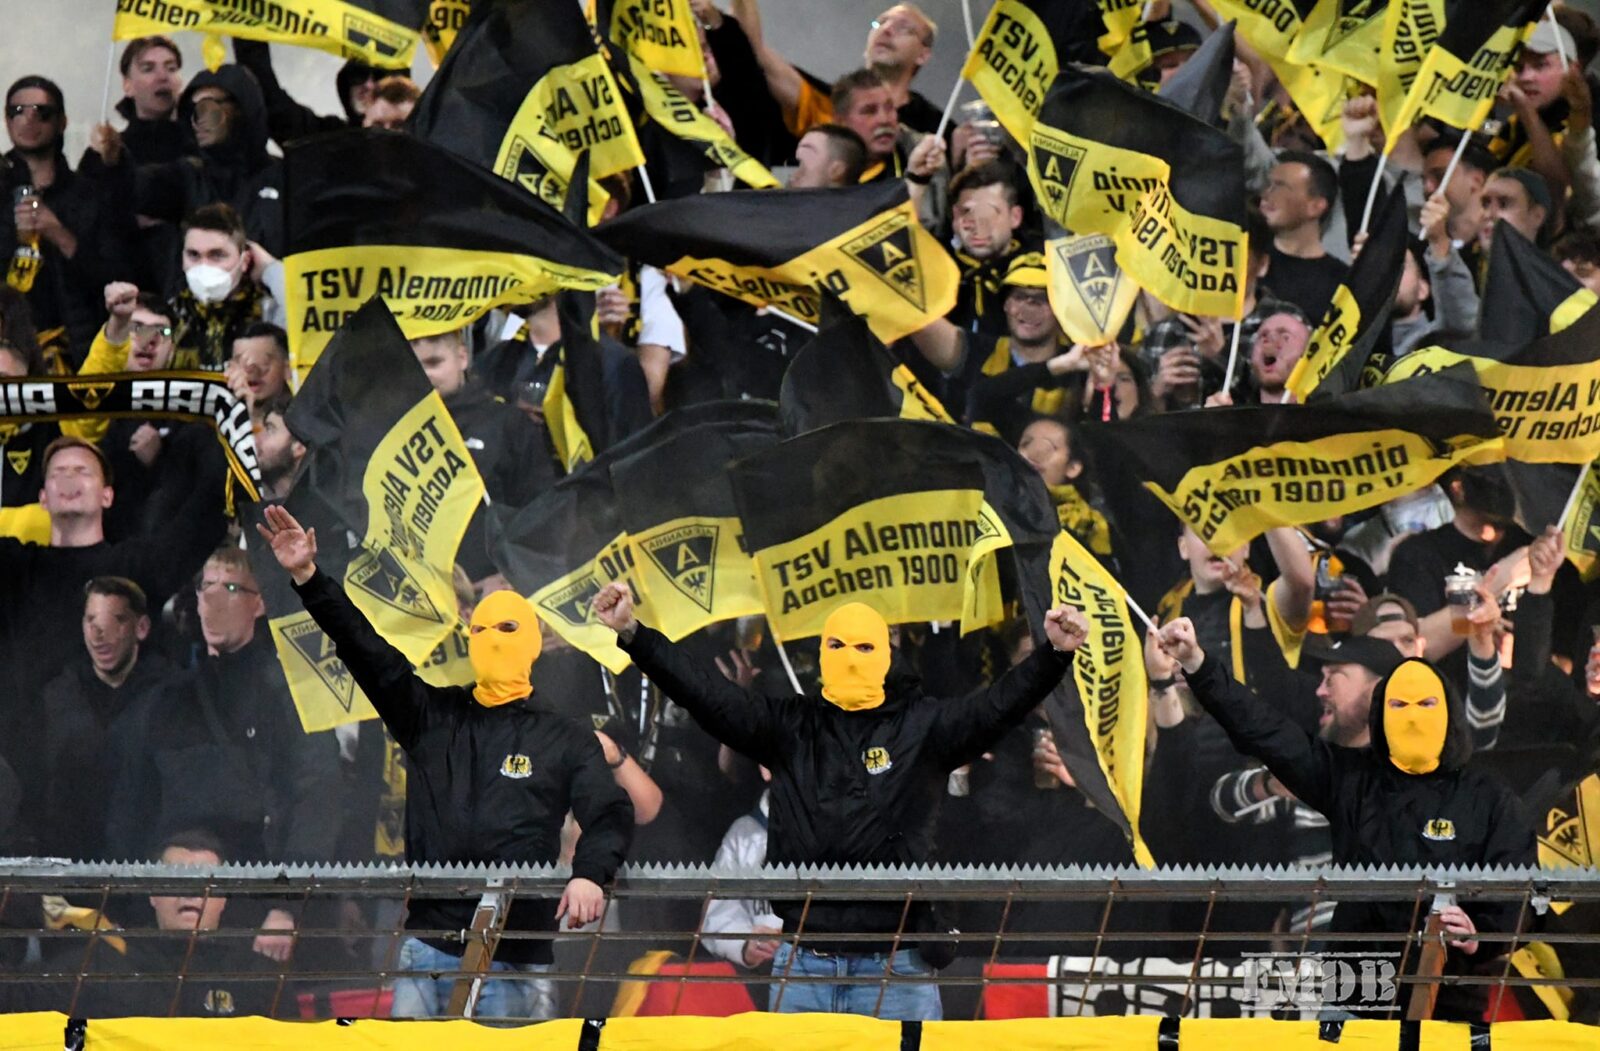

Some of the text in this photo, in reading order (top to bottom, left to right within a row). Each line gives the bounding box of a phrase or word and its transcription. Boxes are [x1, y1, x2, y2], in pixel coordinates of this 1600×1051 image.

[988, 12, 1040, 62] TSV
[301, 266, 366, 301] TSV
[1219, 442, 1410, 482] Alemannia
[1270, 479, 1347, 505] 1900
[772, 539, 831, 588] TSV
[781, 553, 958, 615] Aachen 1900
